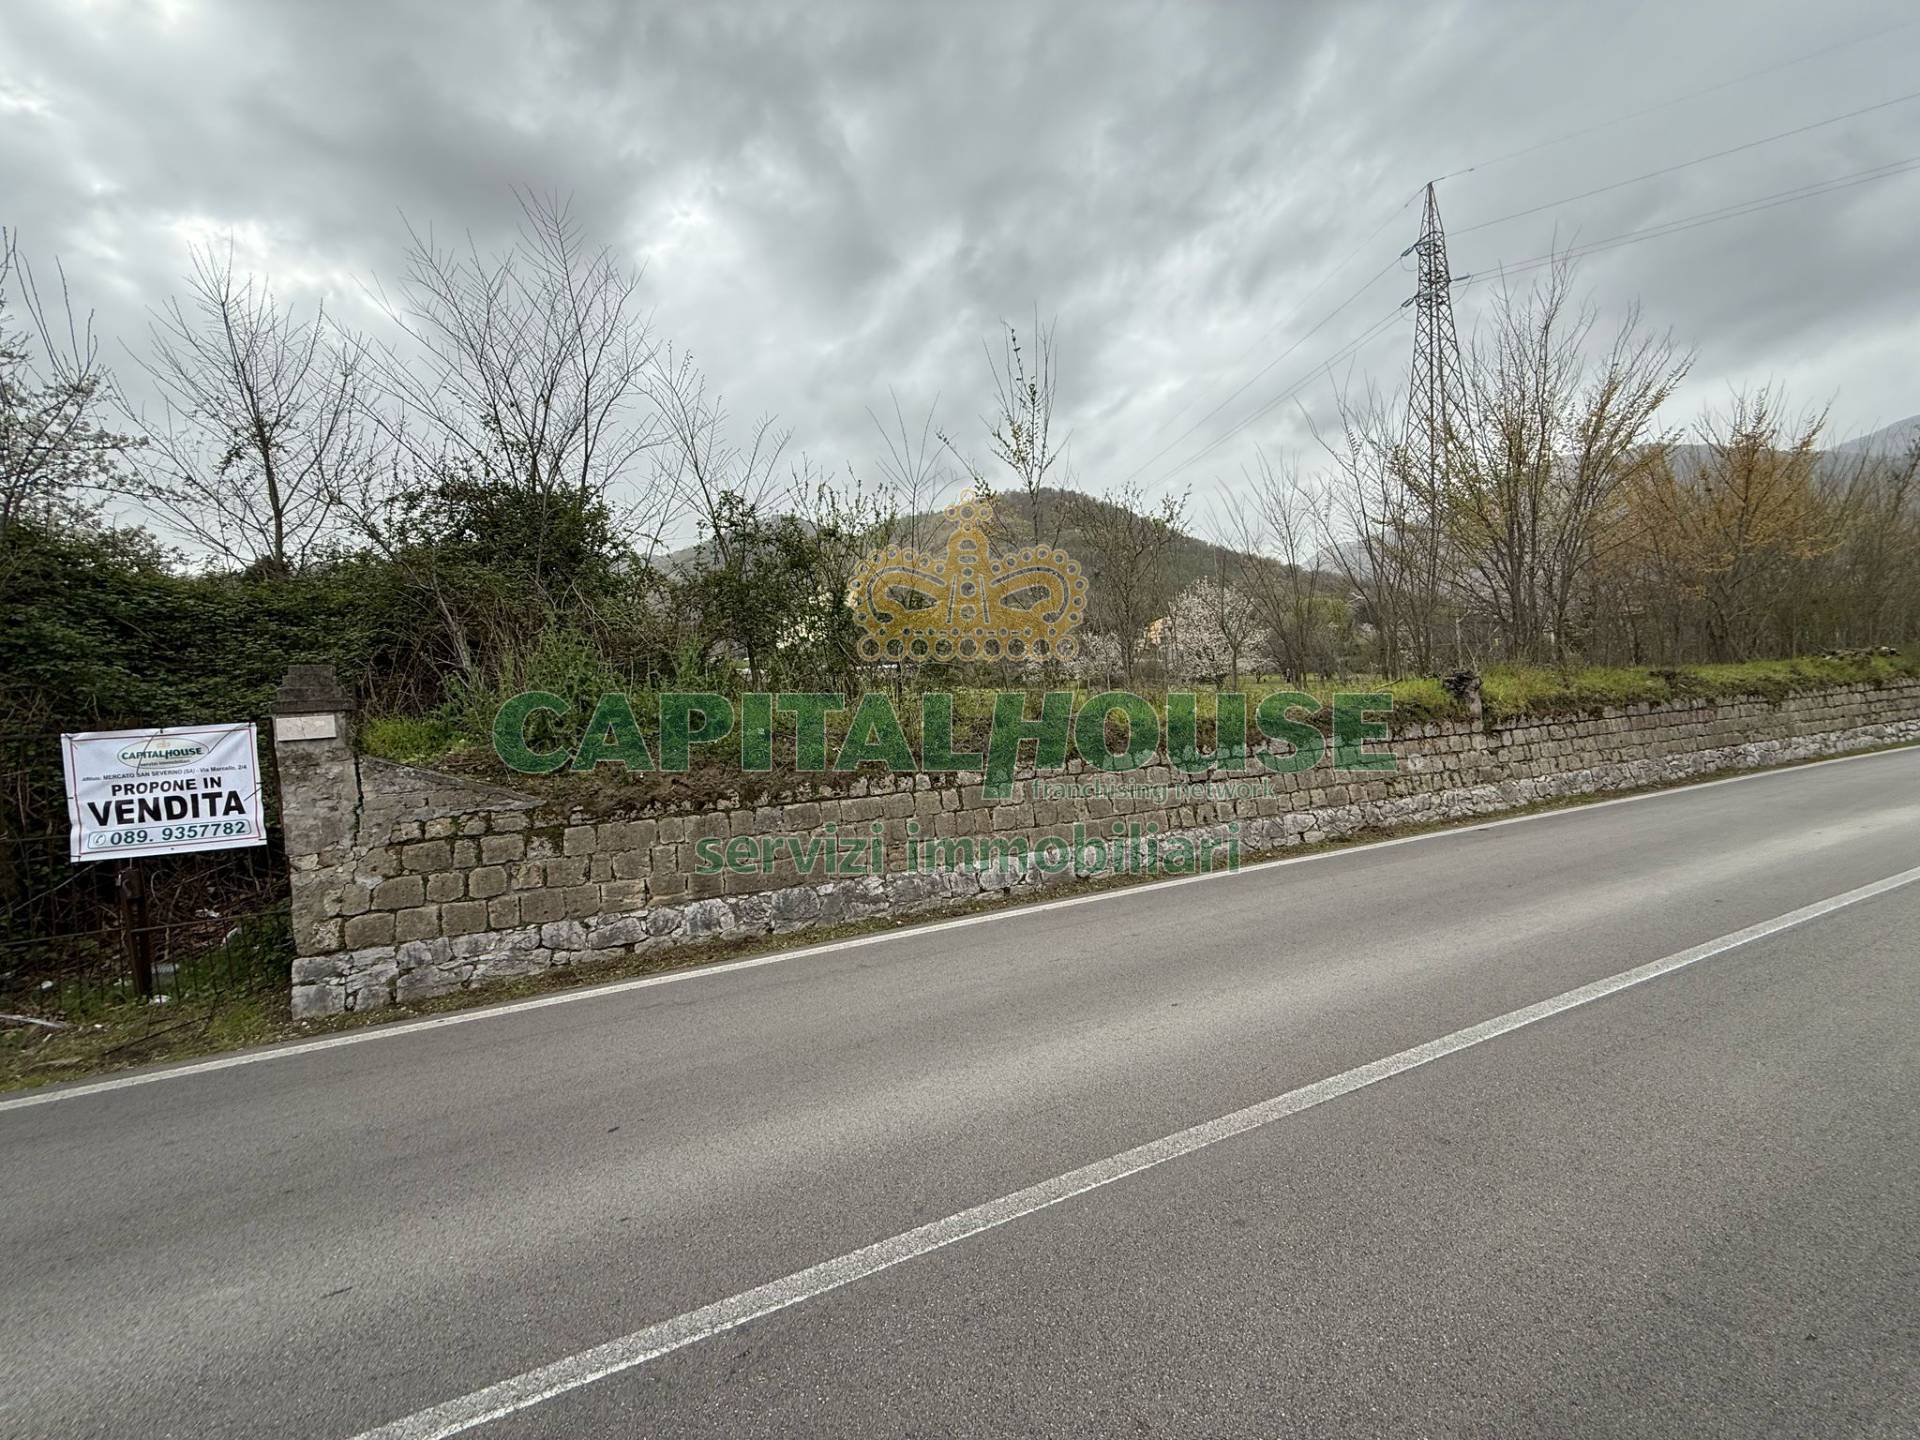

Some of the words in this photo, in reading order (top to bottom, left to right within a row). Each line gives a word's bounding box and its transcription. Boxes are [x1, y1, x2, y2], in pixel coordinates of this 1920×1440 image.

[121, 747, 204, 760] CAPITALHOUSE
[103, 772, 135, 780] MERCATO
[151, 768, 182, 777] SEVERINO
[111, 778, 197, 796] PROPONE
[203, 776, 222, 789] IN
[87, 790, 246, 827] VENDITA
[110, 831, 154, 846] 089.
[161, 821, 246, 841] 9357782
